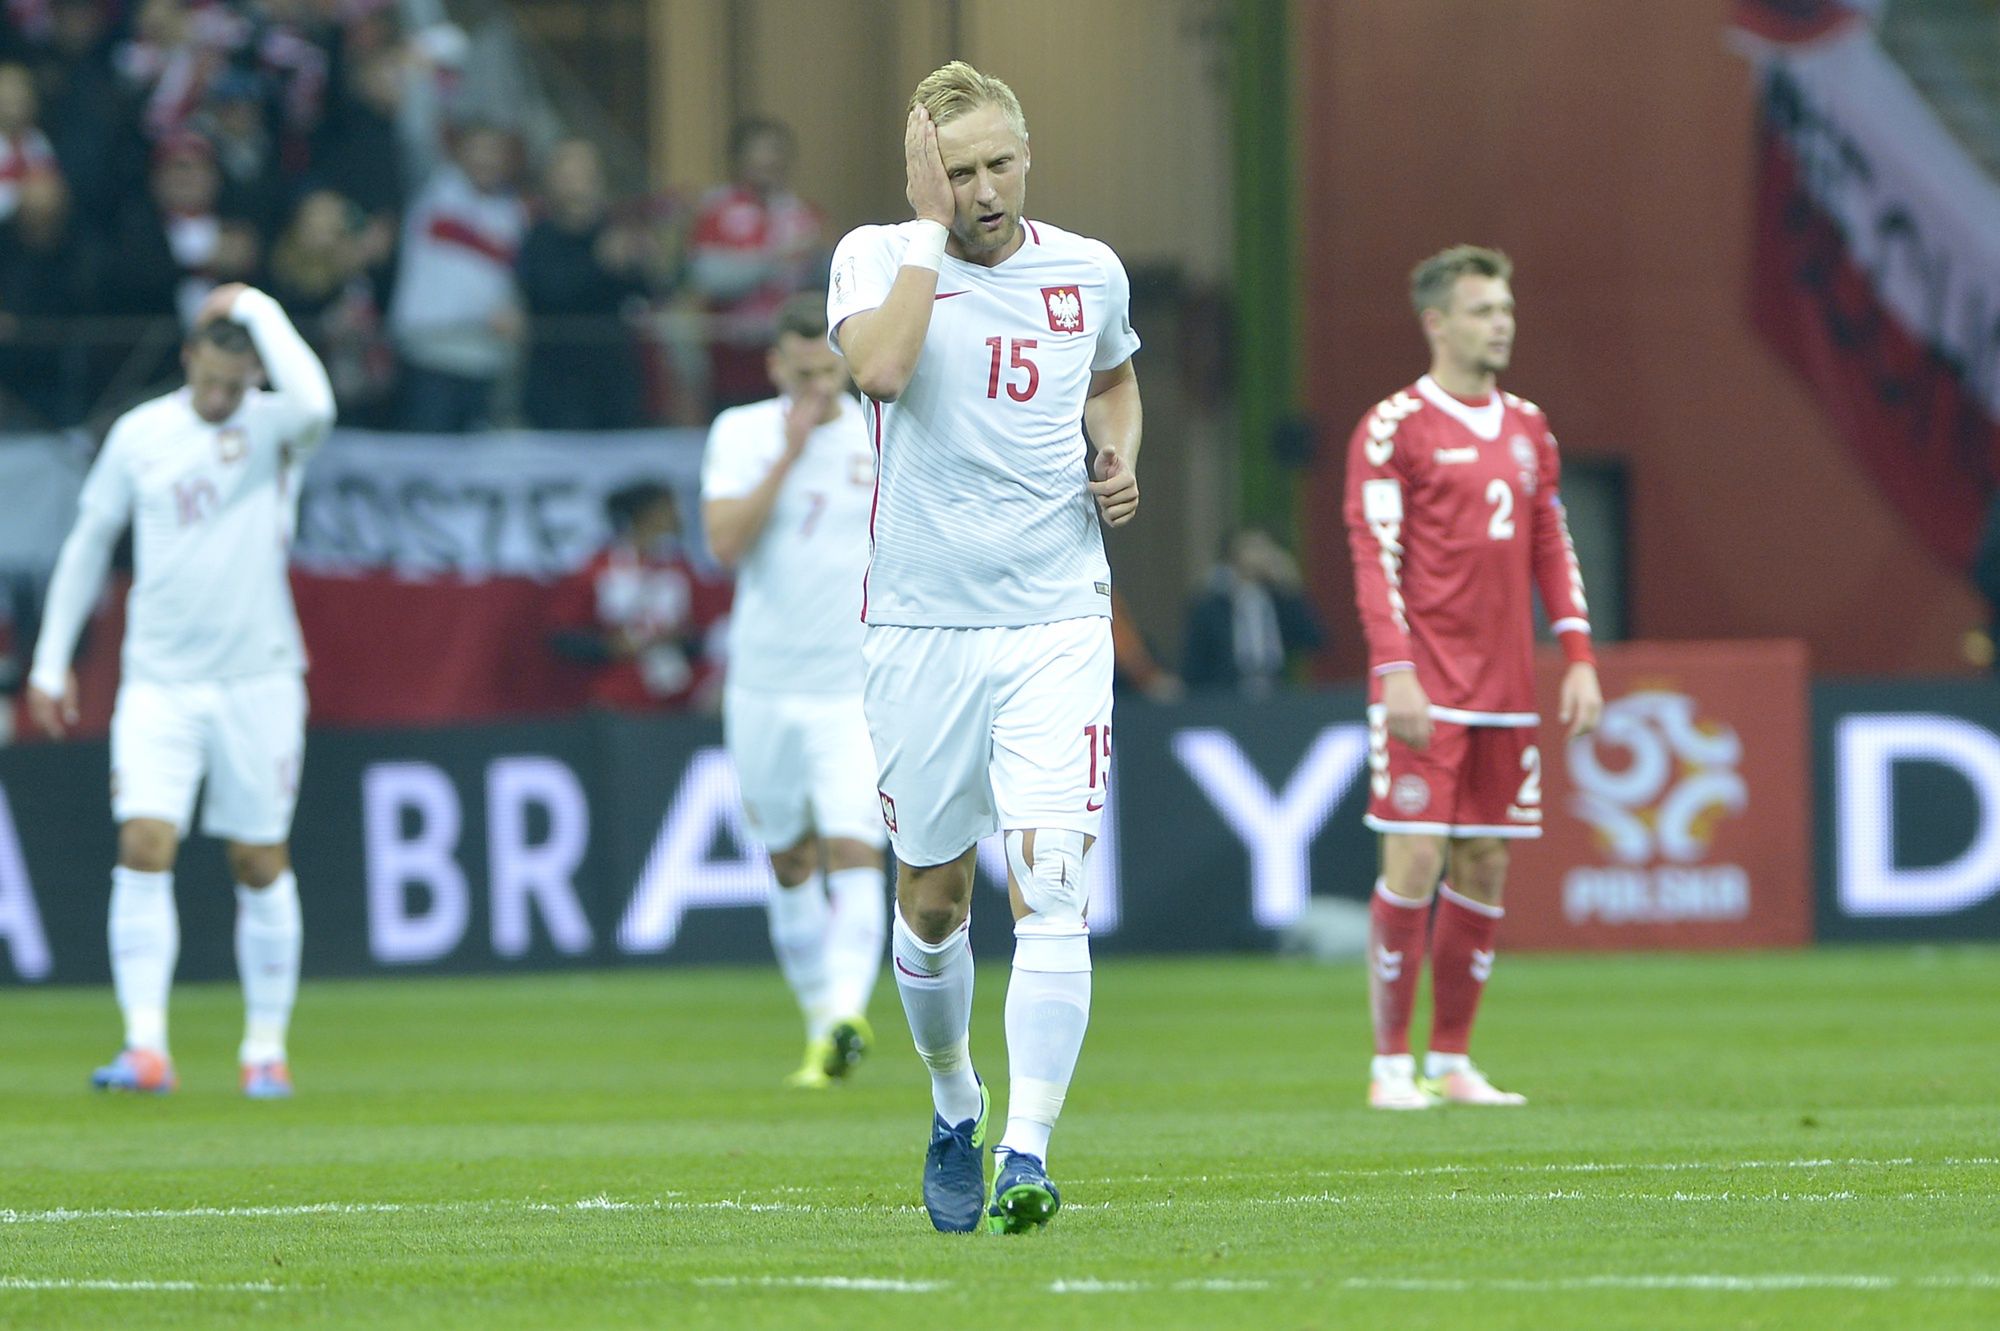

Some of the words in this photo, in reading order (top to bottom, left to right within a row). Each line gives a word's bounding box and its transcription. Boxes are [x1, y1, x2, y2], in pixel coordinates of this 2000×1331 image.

[985, 336, 1039, 402] 15
[801, 491, 829, 539] 7
[1486, 478, 1515, 540] 2
[1517, 744, 1541, 806] 2
[361, 722, 1370, 963] BRAY
[1835, 712, 2000, 919] D
